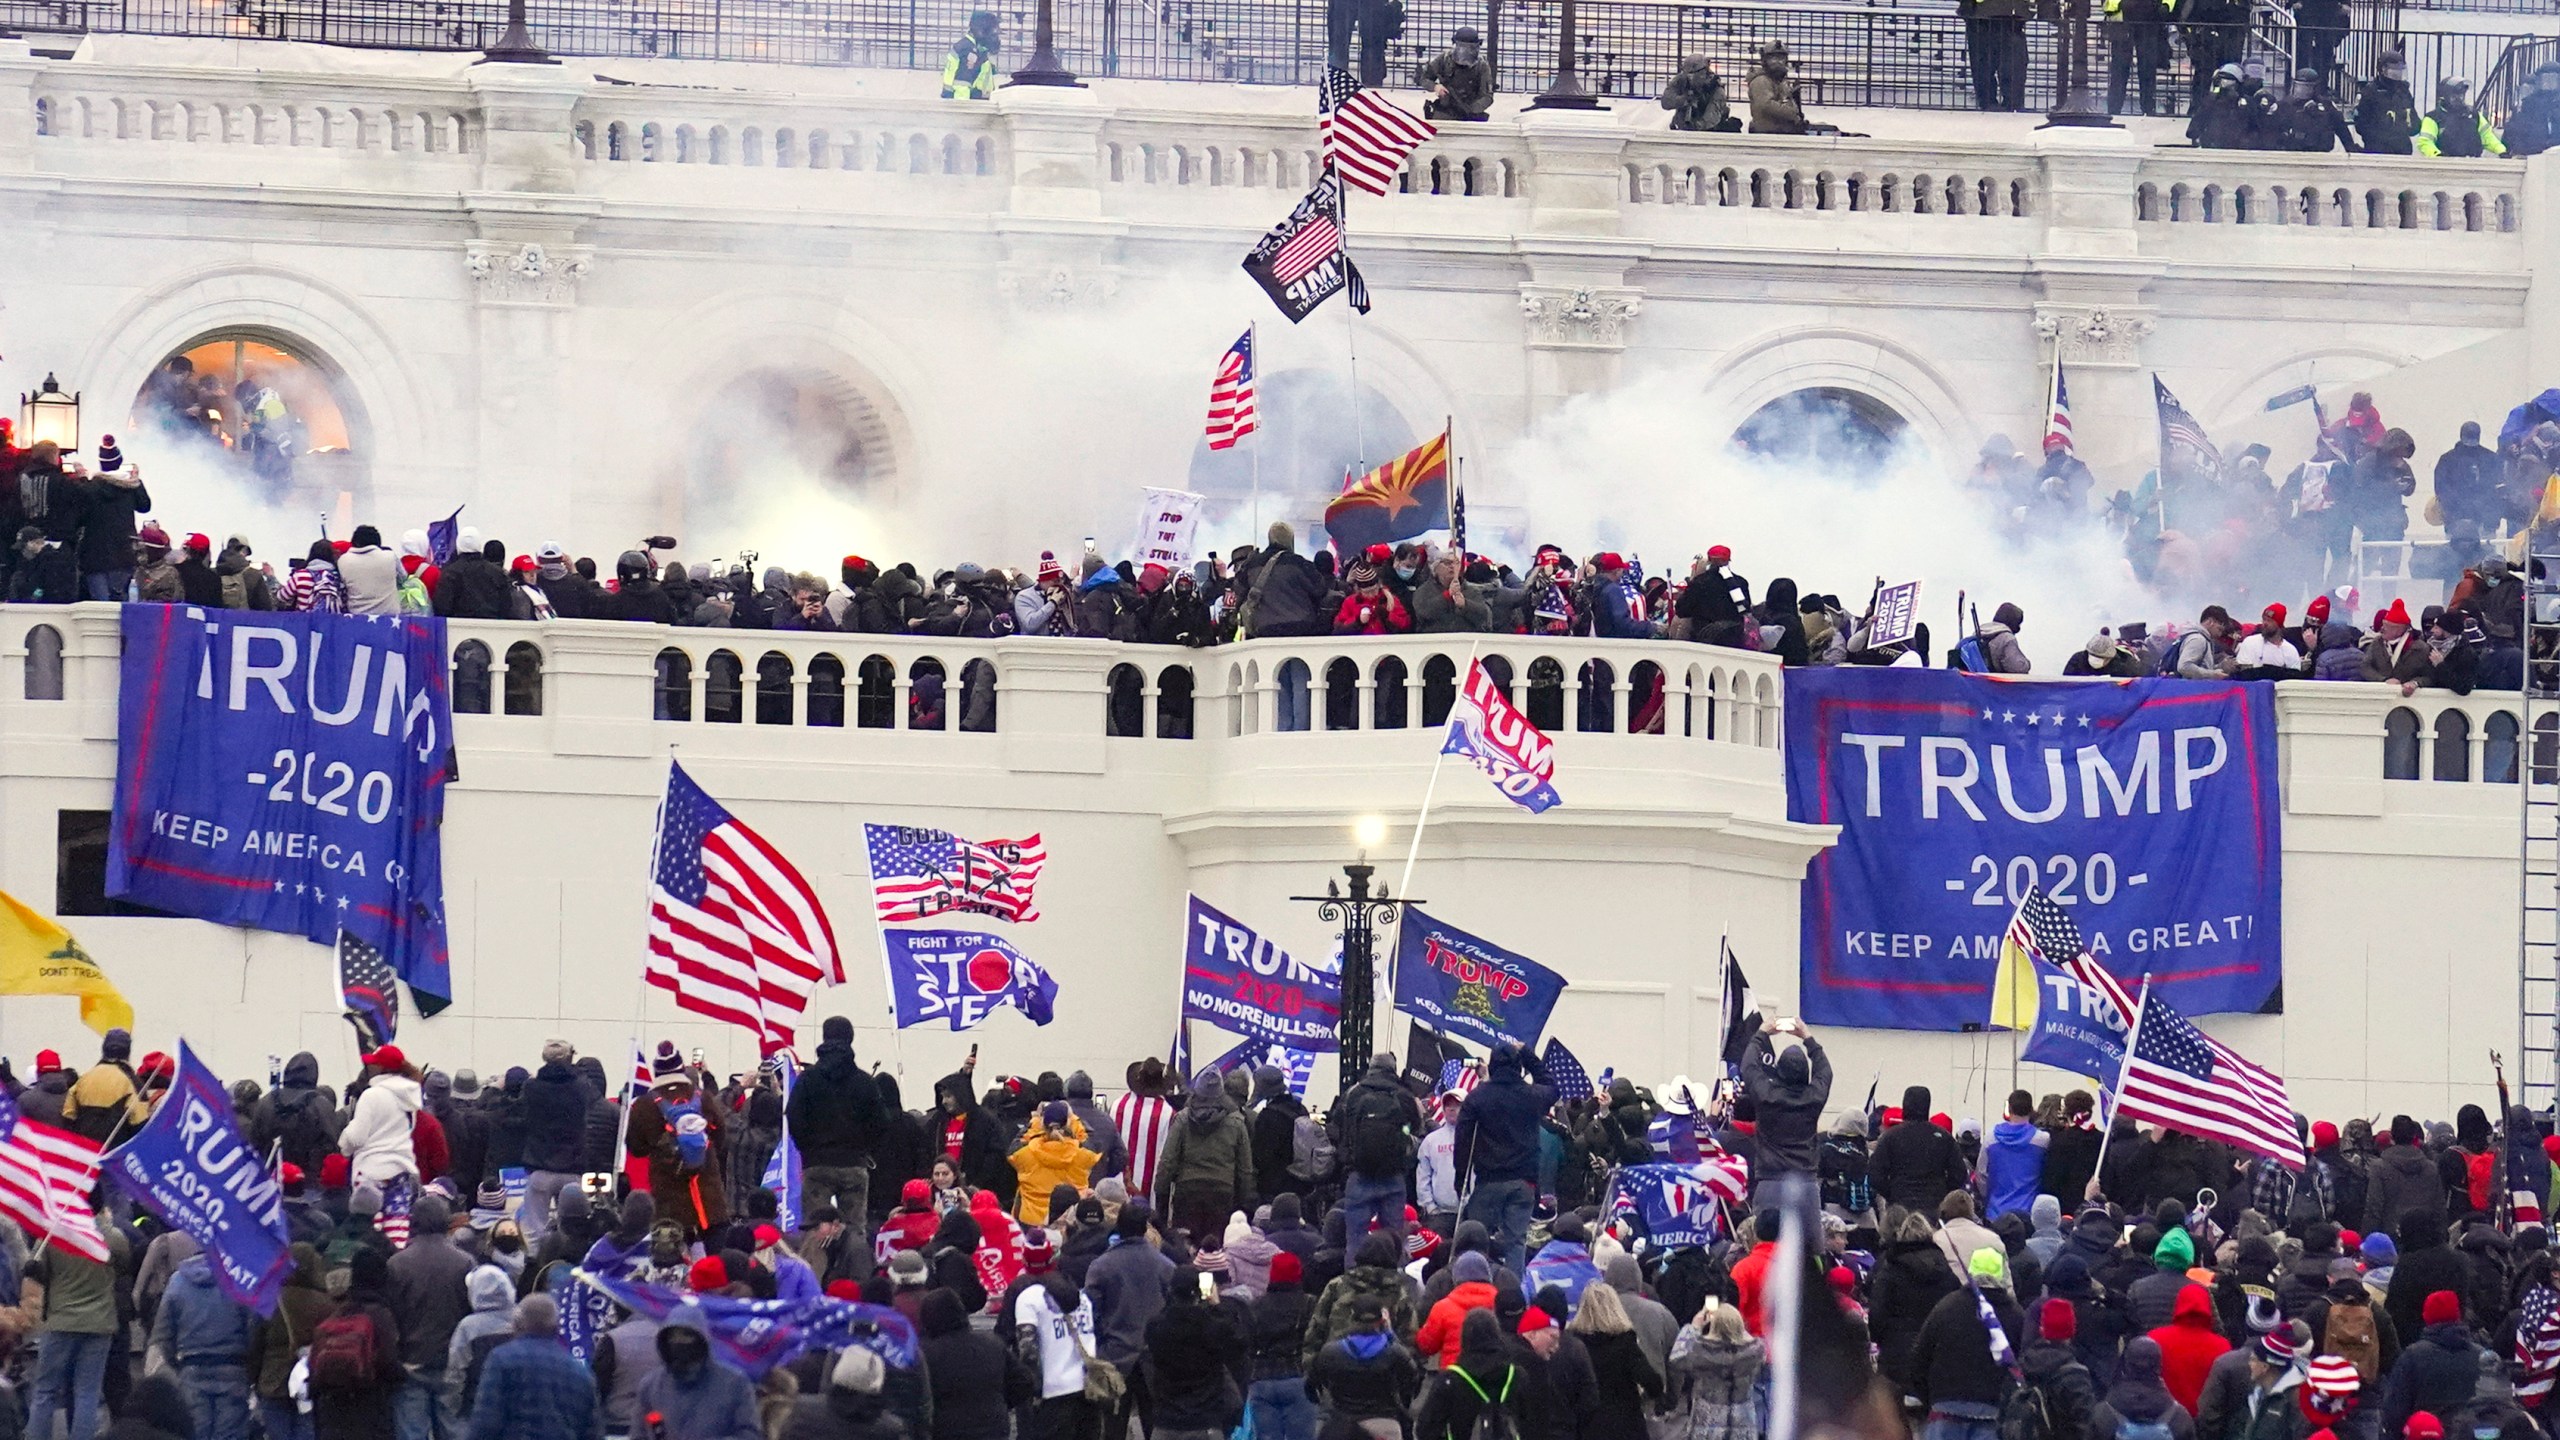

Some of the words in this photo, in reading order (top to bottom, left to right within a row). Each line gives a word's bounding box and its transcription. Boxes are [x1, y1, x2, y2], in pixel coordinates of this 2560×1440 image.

[1876, 601, 1891, 633] 2020
[1891, 585, 1913, 637] TRUMP
[1841, 725, 2228, 824] TRUMP
[152, 810, 230, 850] KEEP
[908, 936, 948, 949] FIGHT
[955, 936, 982, 947] FOR
[1198, 912, 1321, 986] TRUM
[1845, 931, 1932, 958] KEEP
[2127, 914, 2254, 951] GREAT!
[1424, 936, 1529, 1003] TRUMP
[1465, 945, 1506, 966] Tread
[1503, 963, 1527, 977] On
[1188, 989, 1213, 1010] NO
[1213, 999, 1262, 1026] MORE
[1233, 971, 1303, 1016] 2020
[1415, 996, 1443, 1018] KEEP
[1445, 1013, 1495, 1038] AMERICA
[2046, 1021, 2078, 1039] MAKE
